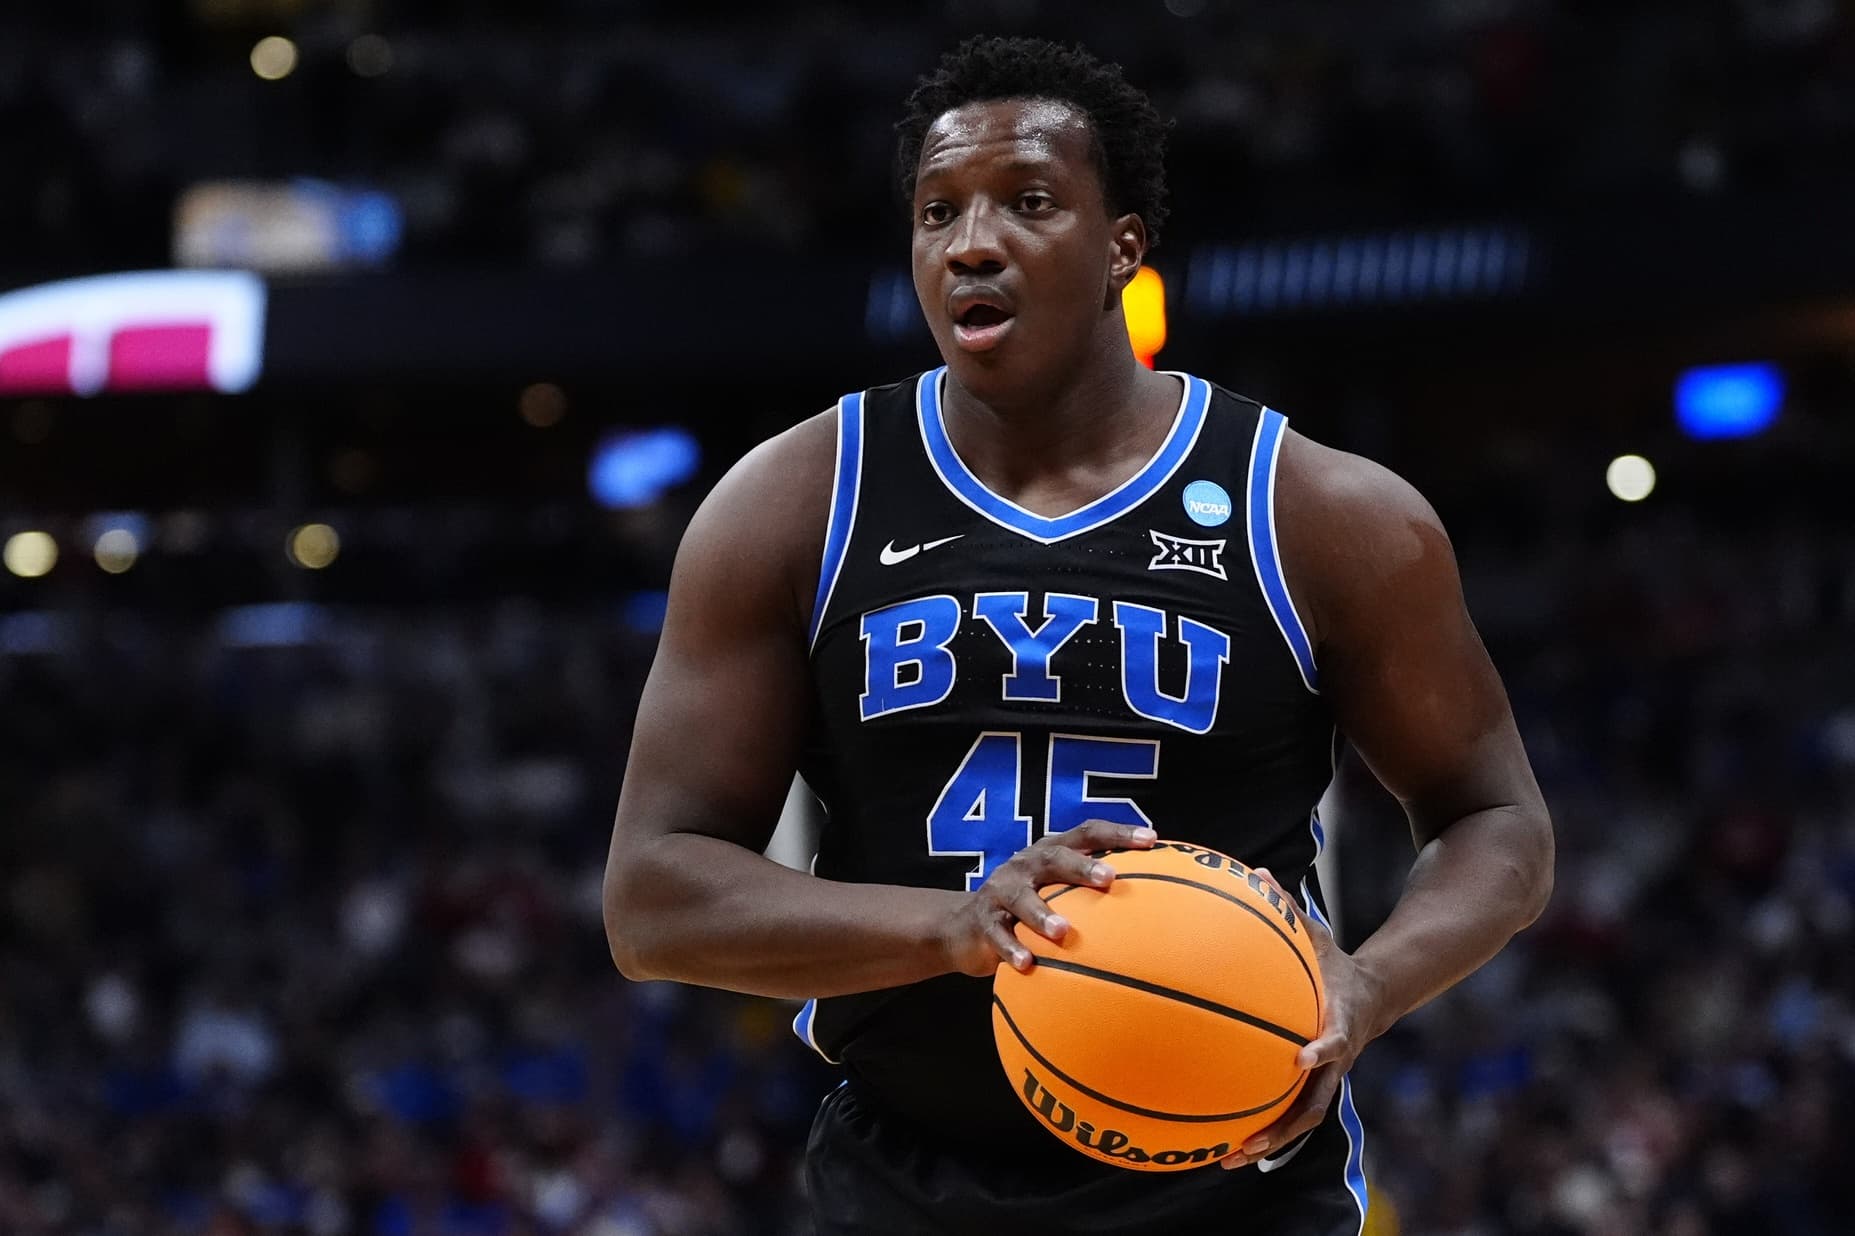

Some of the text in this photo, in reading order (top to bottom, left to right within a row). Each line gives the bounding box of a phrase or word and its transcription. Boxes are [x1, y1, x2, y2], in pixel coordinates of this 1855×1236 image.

[1189, 500, 1229, 516] NCAA
[859, 591, 1231, 735] BYU
[926, 730, 1160, 891] 45
[1023, 1067, 1229, 1165] Wilson
